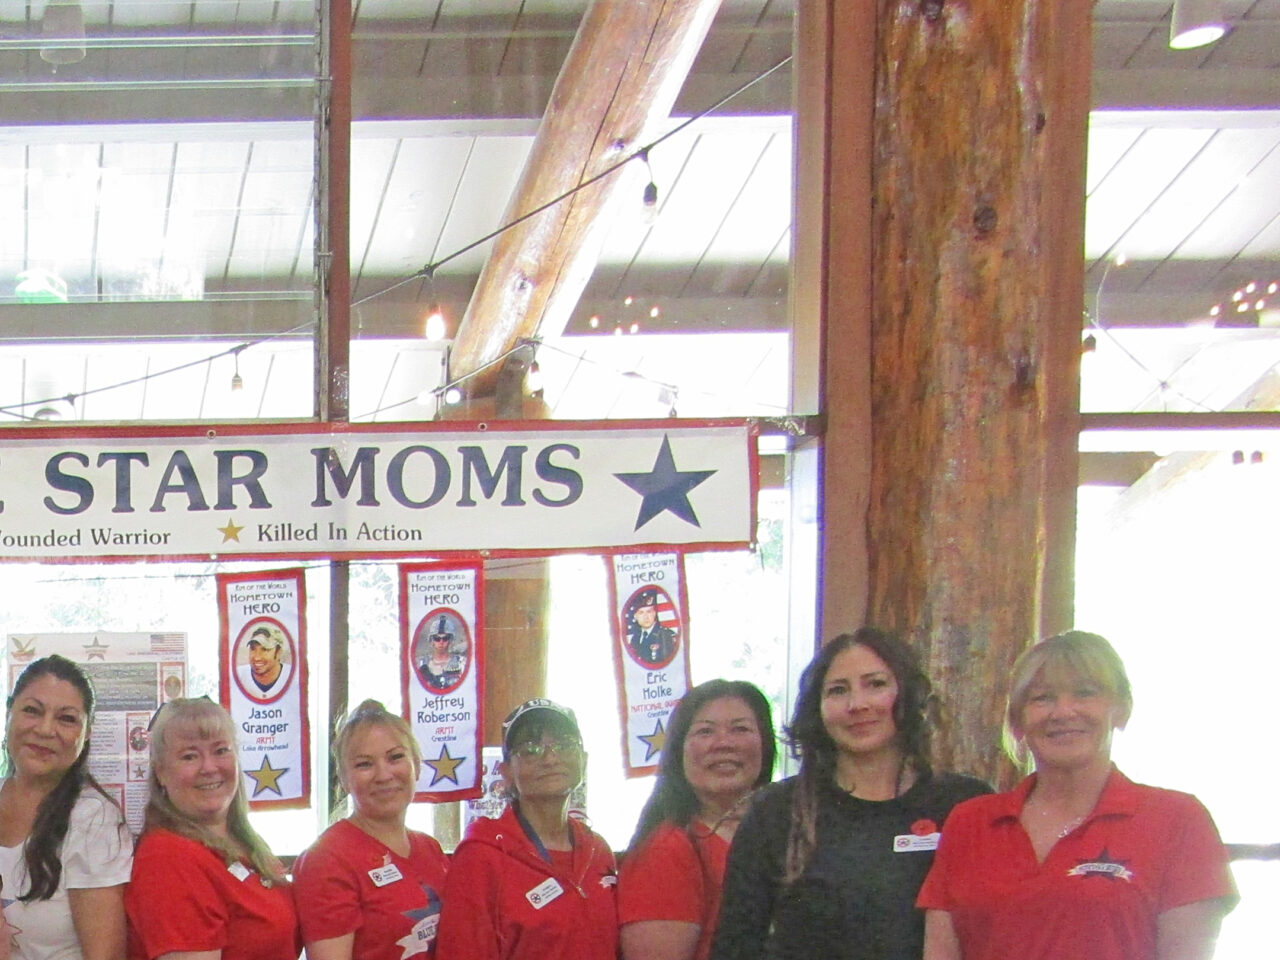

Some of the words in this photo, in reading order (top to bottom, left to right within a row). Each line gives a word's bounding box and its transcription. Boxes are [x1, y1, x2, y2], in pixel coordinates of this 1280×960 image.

[43, 449, 273, 515] STAR
[310, 444, 584, 509] MOMS
[90, 528, 171, 547] Warrior
[257, 523, 319, 544] Killed
[327, 524, 349, 542] In
[356, 522, 423, 542] Action
[617, 559, 675, 572] HOMETOWN
[631, 570, 665, 584] HERO
[411, 583, 471, 592] HOMETOWN
[230, 591, 293, 603] HOMETOWN
[424, 594, 460, 605] HERO
[243, 602, 281, 615] HERO
[646, 672, 668, 685] Eric
[422, 695, 465, 711] Jeffrey
[248, 707, 283, 719] Jason
[417, 711, 471, 724] Roberson
[242, 722, 289, 736] Granger
[257, 743, 289, 752] Arrowhead
